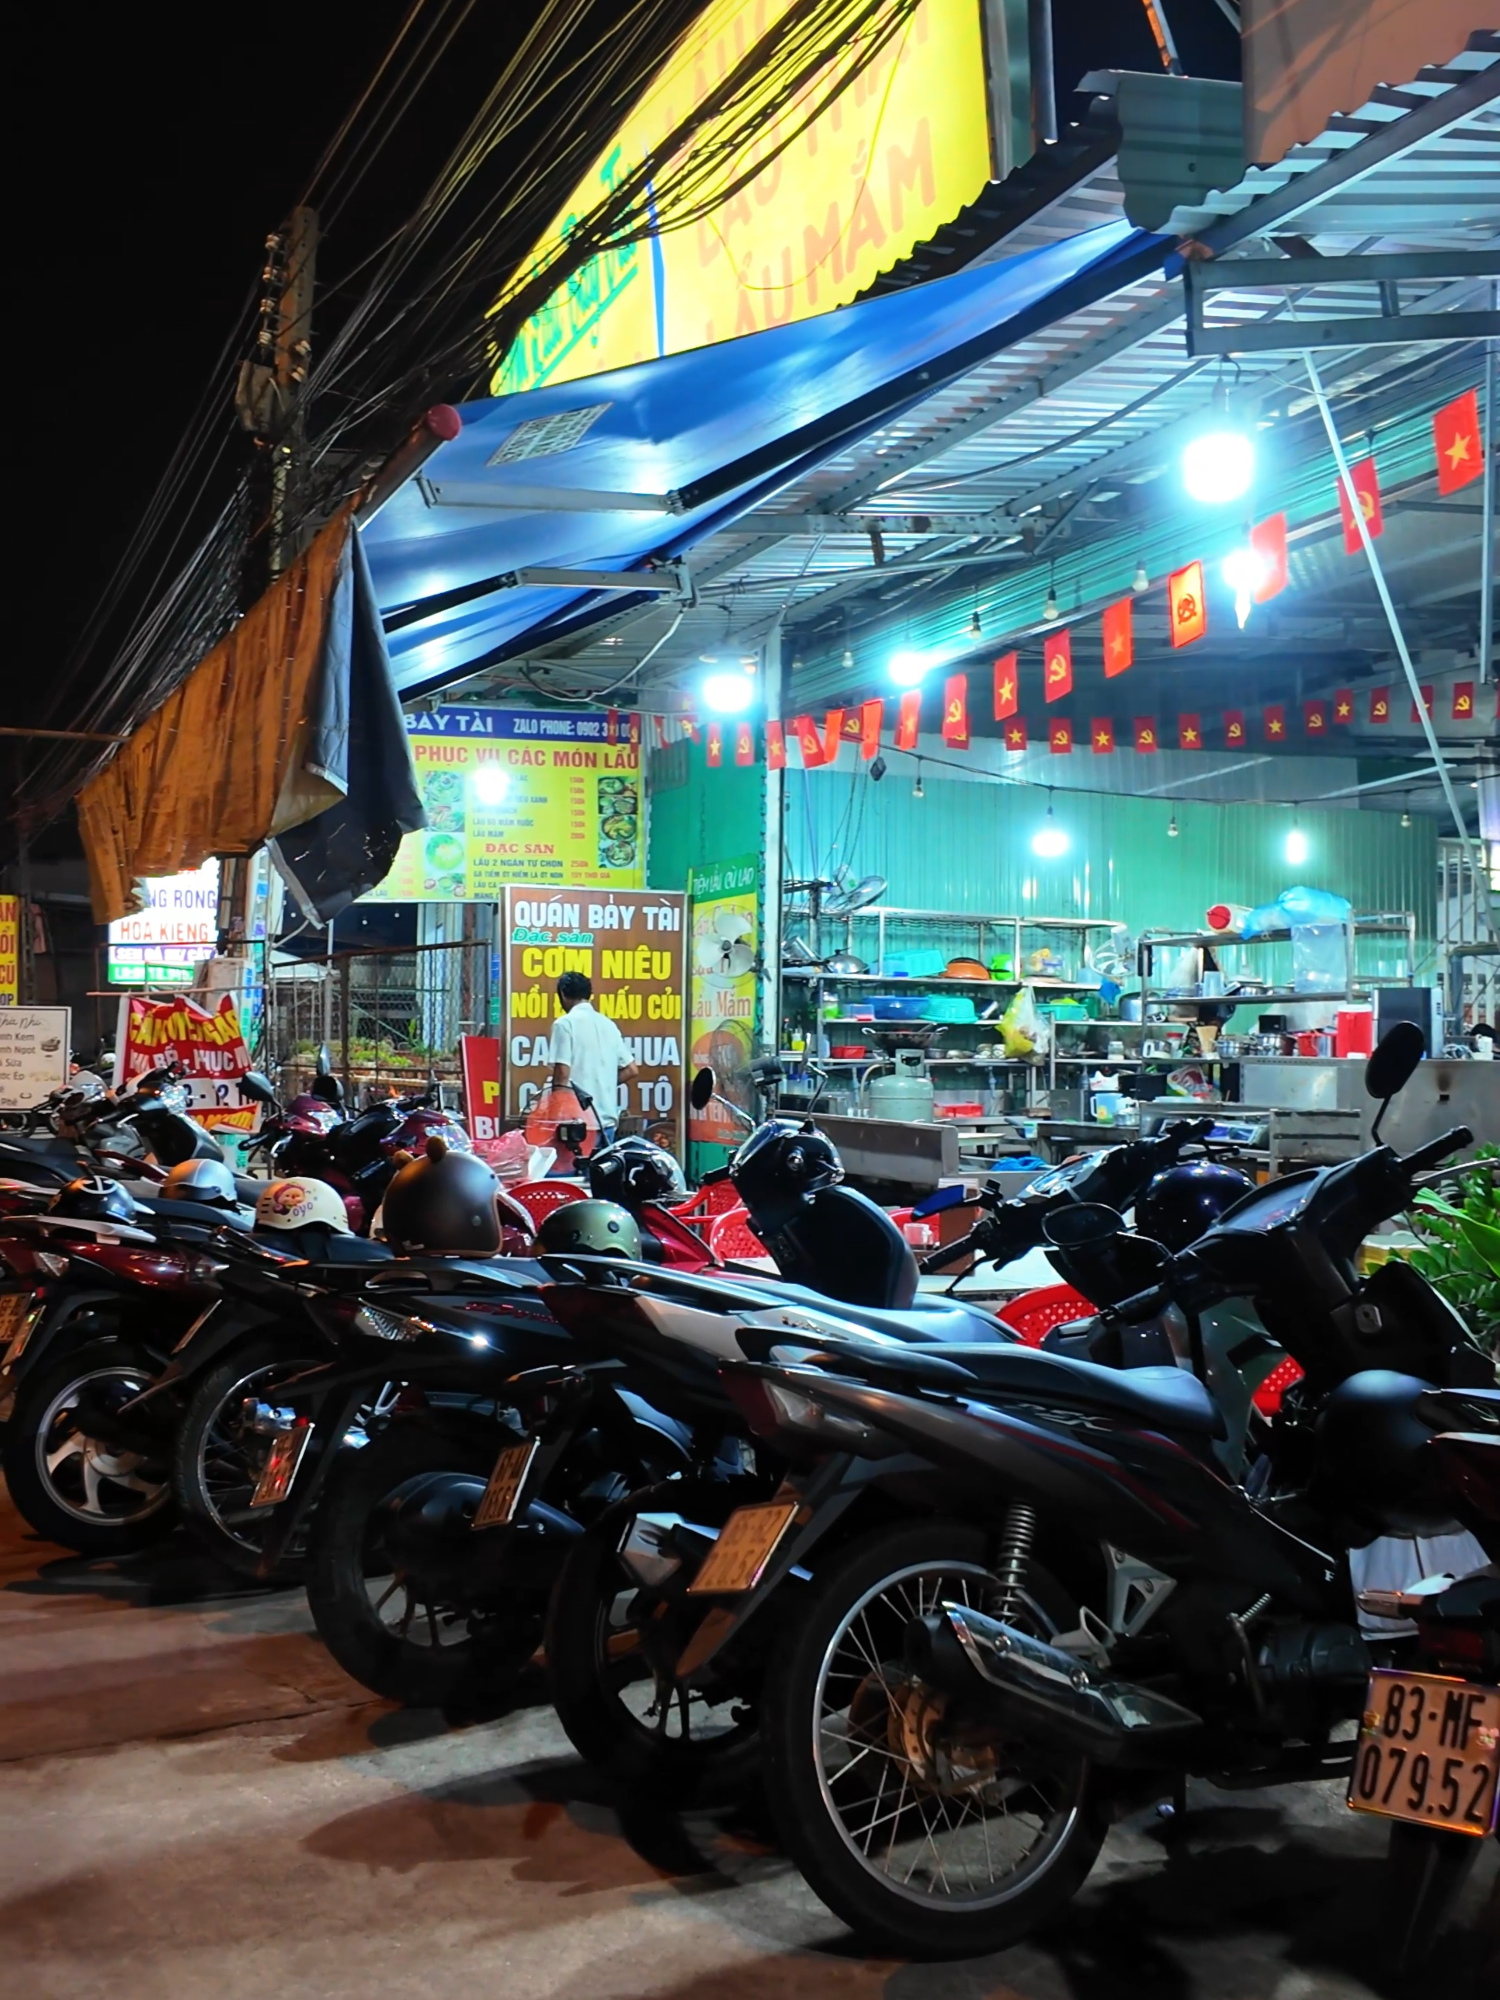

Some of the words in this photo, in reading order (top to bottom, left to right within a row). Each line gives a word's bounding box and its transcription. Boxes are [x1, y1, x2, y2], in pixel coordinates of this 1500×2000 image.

[803, 117, 936, 306] MẮM
[455, 712, 493, 732] TÀI
[513, 718, 538, 734] ZALO
[576, 721, 600, 737] 0902
[414, 745, 468, 766] PHỤC
[508, 746, 546, 766] CÁC
[553, 748, 597, 768] MÓN
[492, 859, 498, 867] 2
[514, 894, 579, 928] QUÁN
[642, 898, 680, 931] TÀI
[512, 927, 552, 945] Đặc
[522, 946, 593, 979] CƠM
[602, 945, 671, 980] NIÊU
[511, 984, 548, 1019] NỒI
[599, 985, 642, 1020] NẤU
[647, 987, 681, 1020] CỦI
[511, 1035, 551, 1066] CA
[623, 1037, 680, 1066] HUA
[637, 1075, 673, 1118] TỘ
[1359, 1745, 1489, 1822] 079.52
